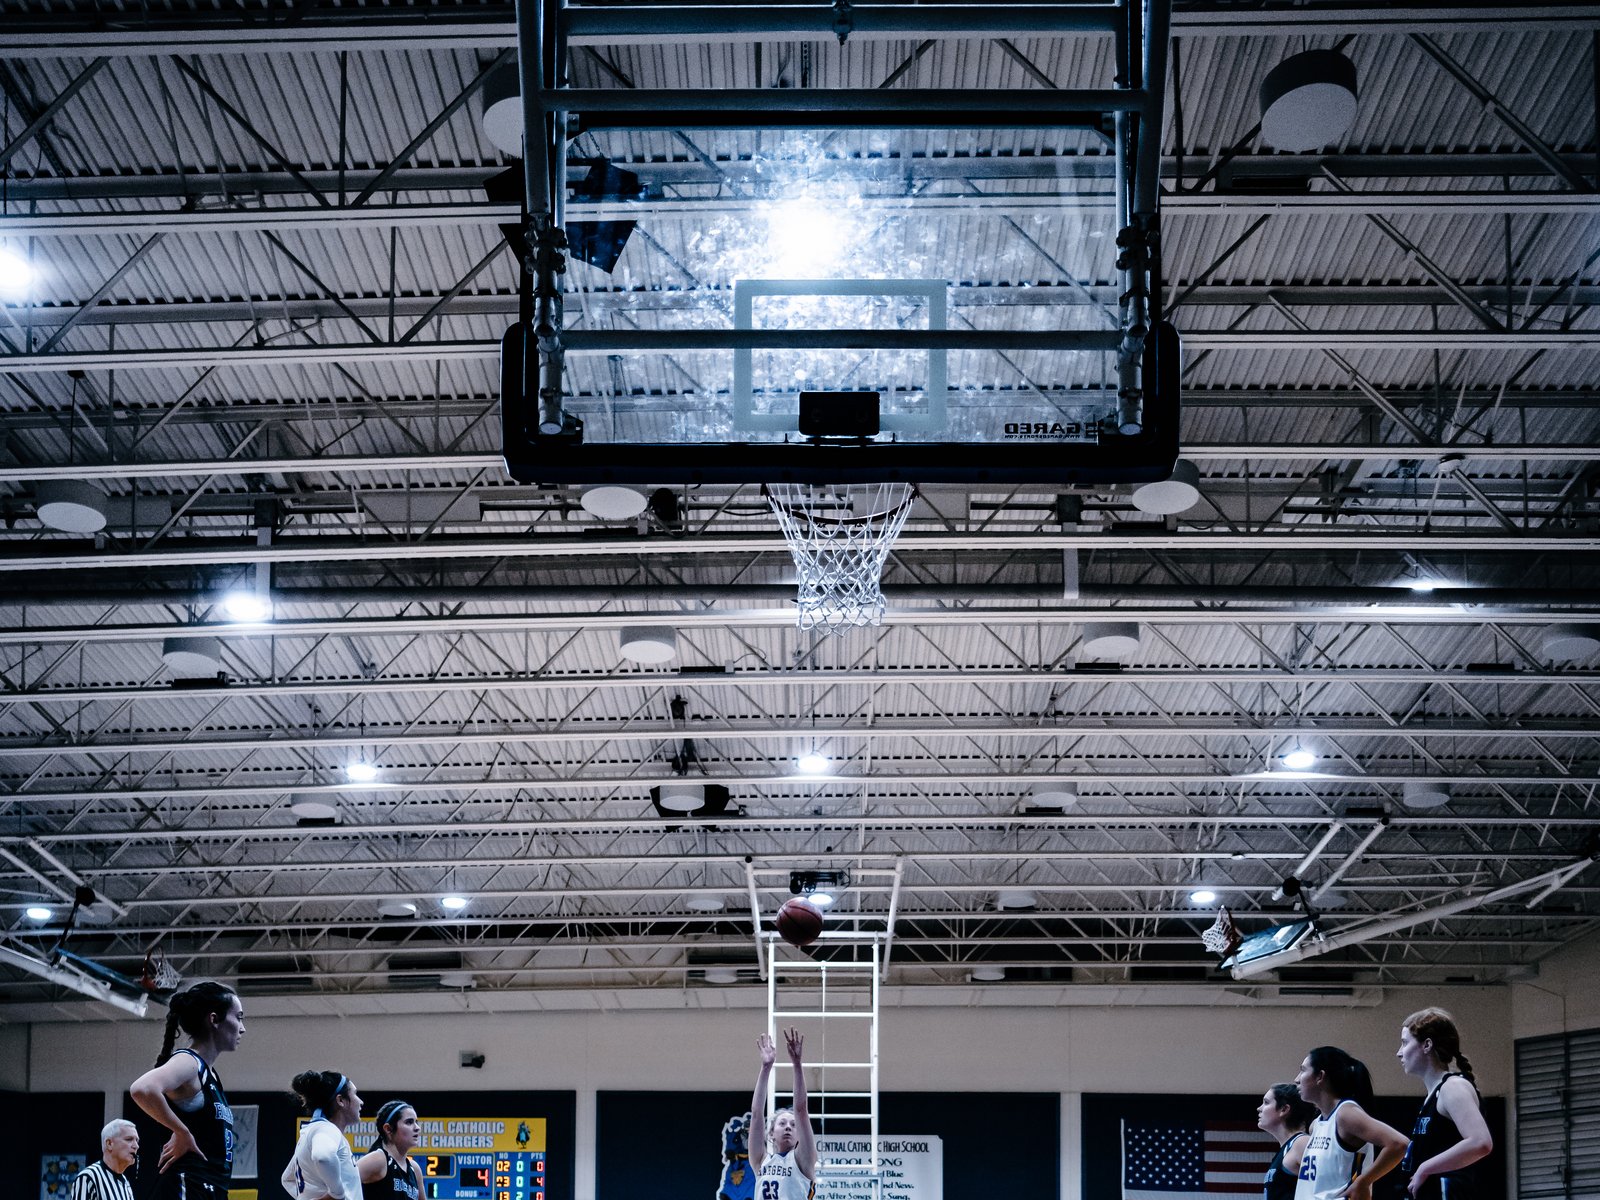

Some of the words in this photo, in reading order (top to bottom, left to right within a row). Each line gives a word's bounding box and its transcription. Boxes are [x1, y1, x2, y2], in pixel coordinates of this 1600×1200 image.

[447, 1121, 505, 1135] CATHOLIC
[431, 1135, 494, 1148] CHARGERS
[847, 1141, 882, 1152] CATHOC
[883, 1142, 900, 1152] HIGH
[901, 1141, 929, 1153] SCHOOL
[457, 1155, 493, 1165] VISITOR
[496, 1161, 510, 1172] 02
[516, 1161, 524, 1172] 0
[536, 1161, 544, 1172] 0
[1299, 1155, 1317, 1181] 25
[477, 1168, 489, 1187] 4
[886, 1170, 904, 1178] Blue
[516, 1176, 524, 1187] 0
[536, 1176, 544, 1187] 4
[455, 1190, 478, 1198] BONUS
[762, 1180, 779, 1200] 23
[826, 1192, 846, 1200] After
[848, 1192, 872, 1200] Songs
